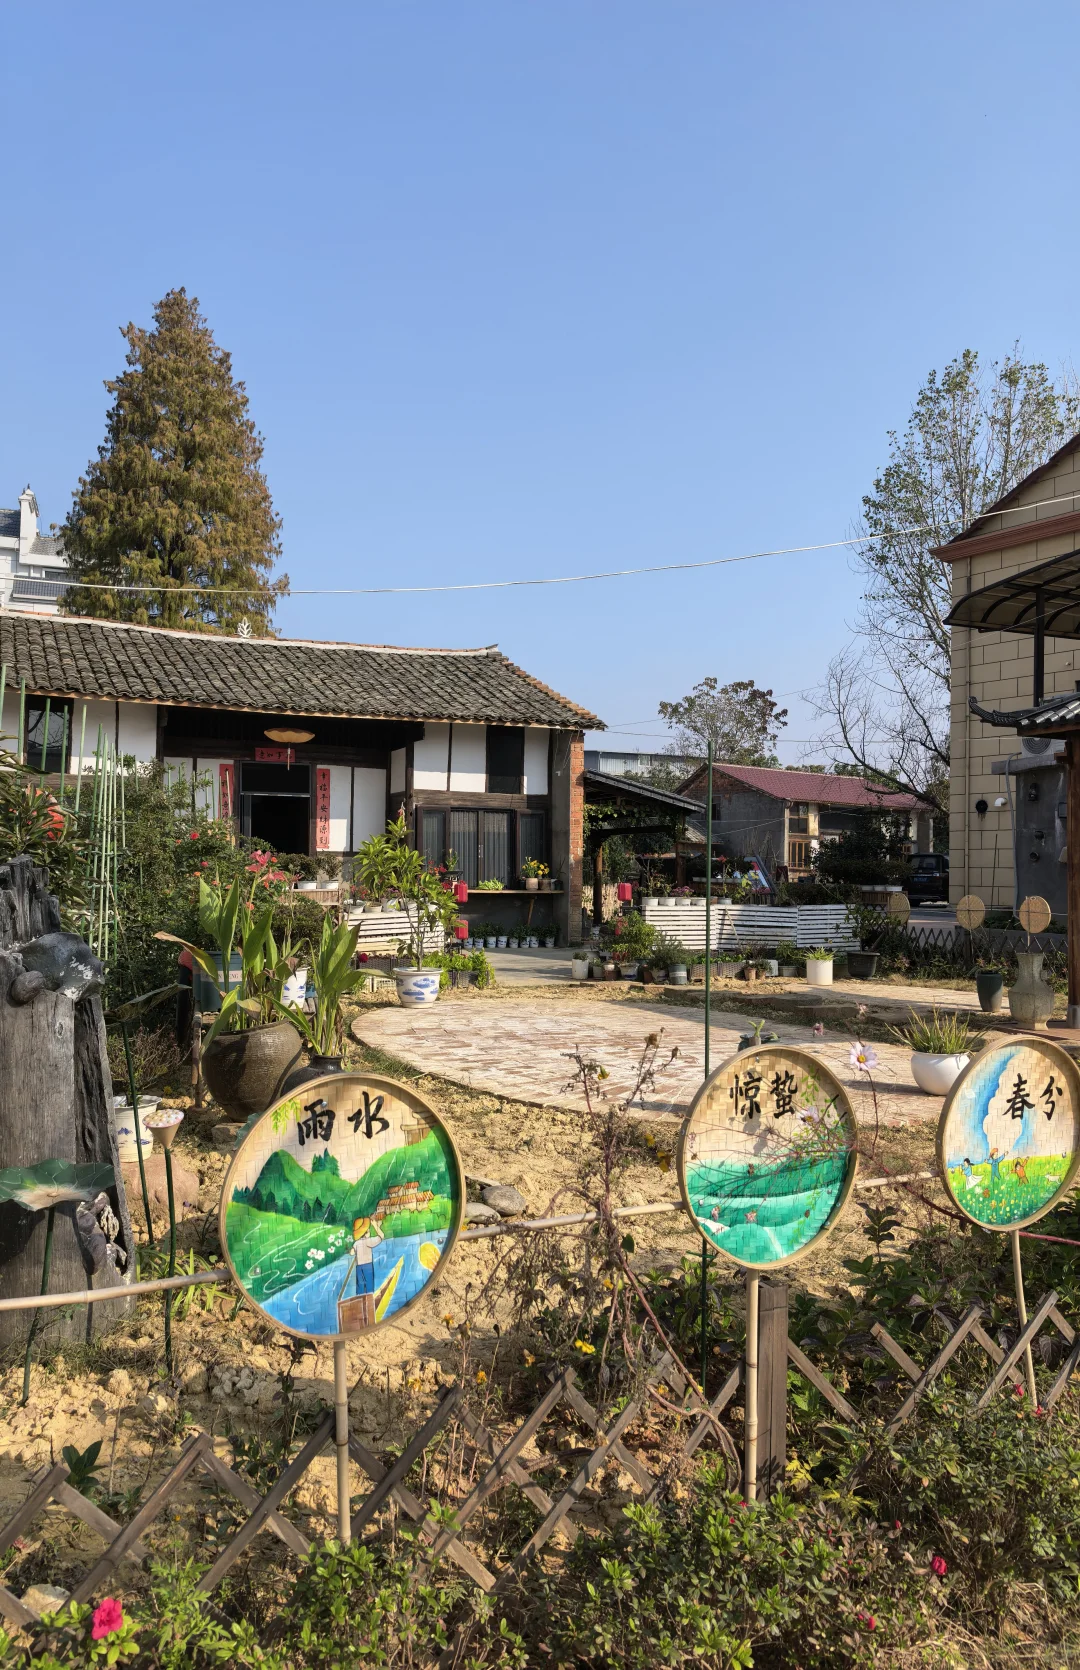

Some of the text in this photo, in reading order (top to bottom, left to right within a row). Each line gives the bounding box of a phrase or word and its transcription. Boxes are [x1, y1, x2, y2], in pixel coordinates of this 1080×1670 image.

[297, 1091, 390, 1146] 雨水
[729, 1070, 798, 1119] 惊蛰
[1003, 1073, 1063, 1120] 春分
